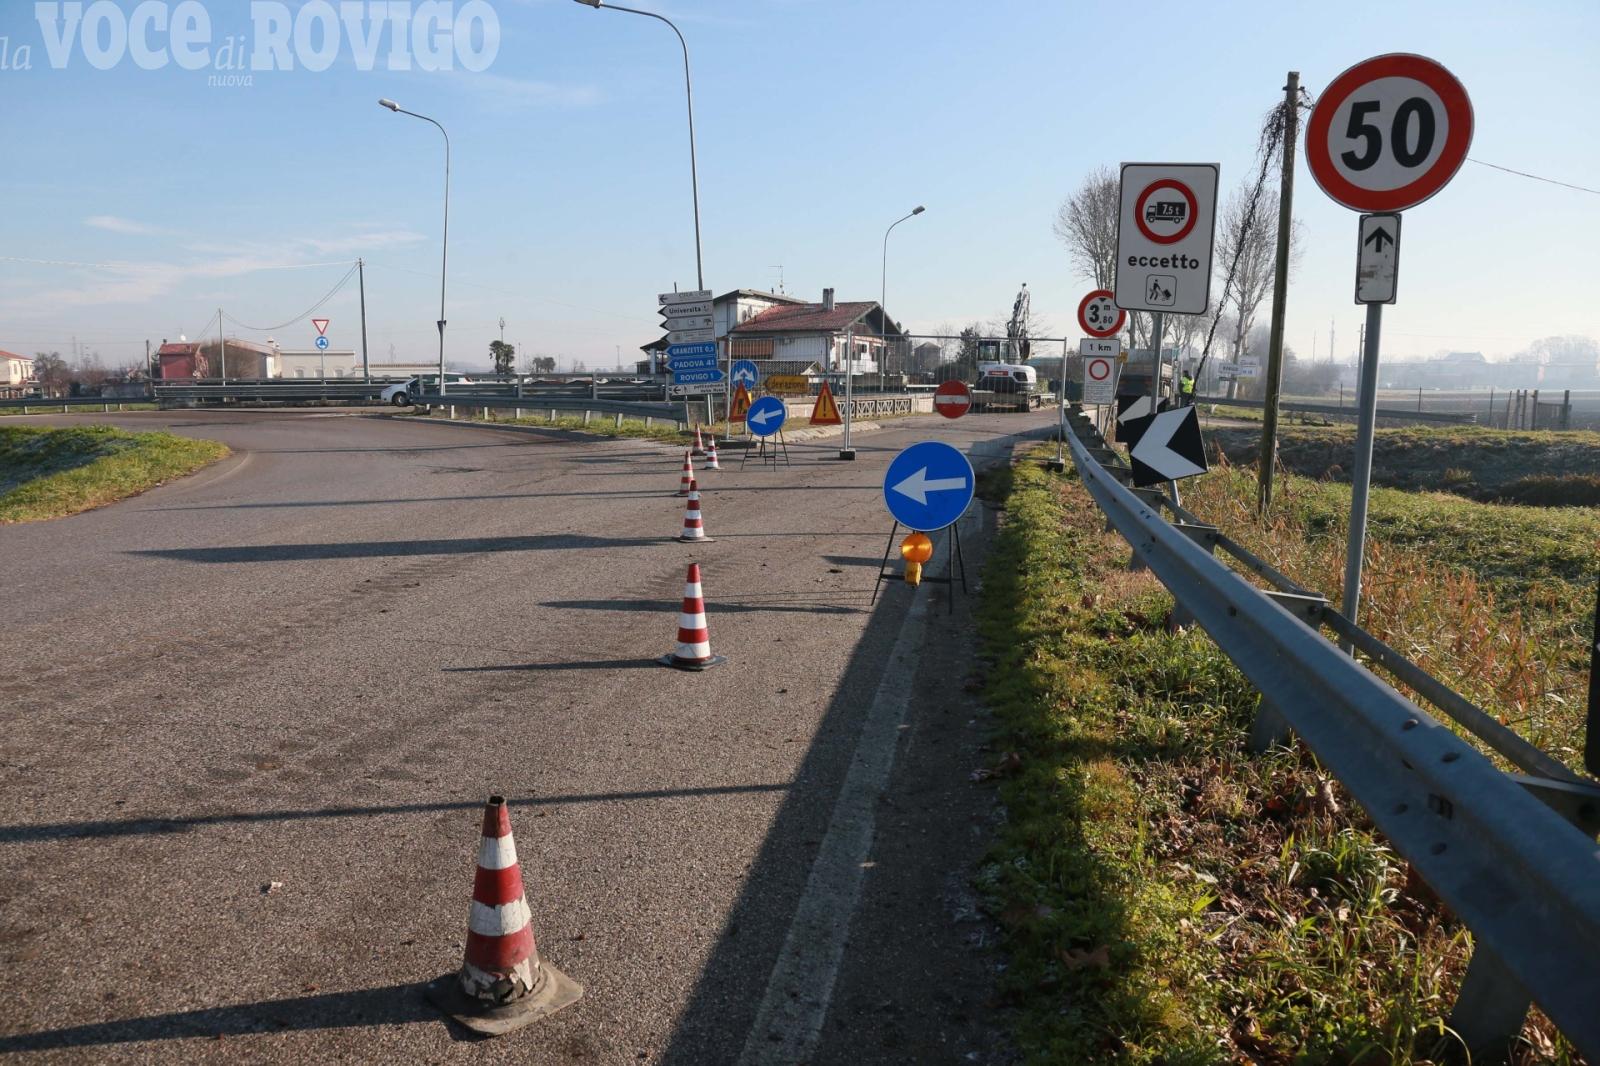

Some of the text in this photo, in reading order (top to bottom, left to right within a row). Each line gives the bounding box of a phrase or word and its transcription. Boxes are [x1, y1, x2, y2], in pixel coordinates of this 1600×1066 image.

[1341, 96, 1435, 171] 50
[1128, 254, 1199, 269] eccetto
[672, 346, 704, 355] GRANZETTE
[674, 360, 704, 368] PADOVA
[680, 373, 709, 381] ROVIGO
